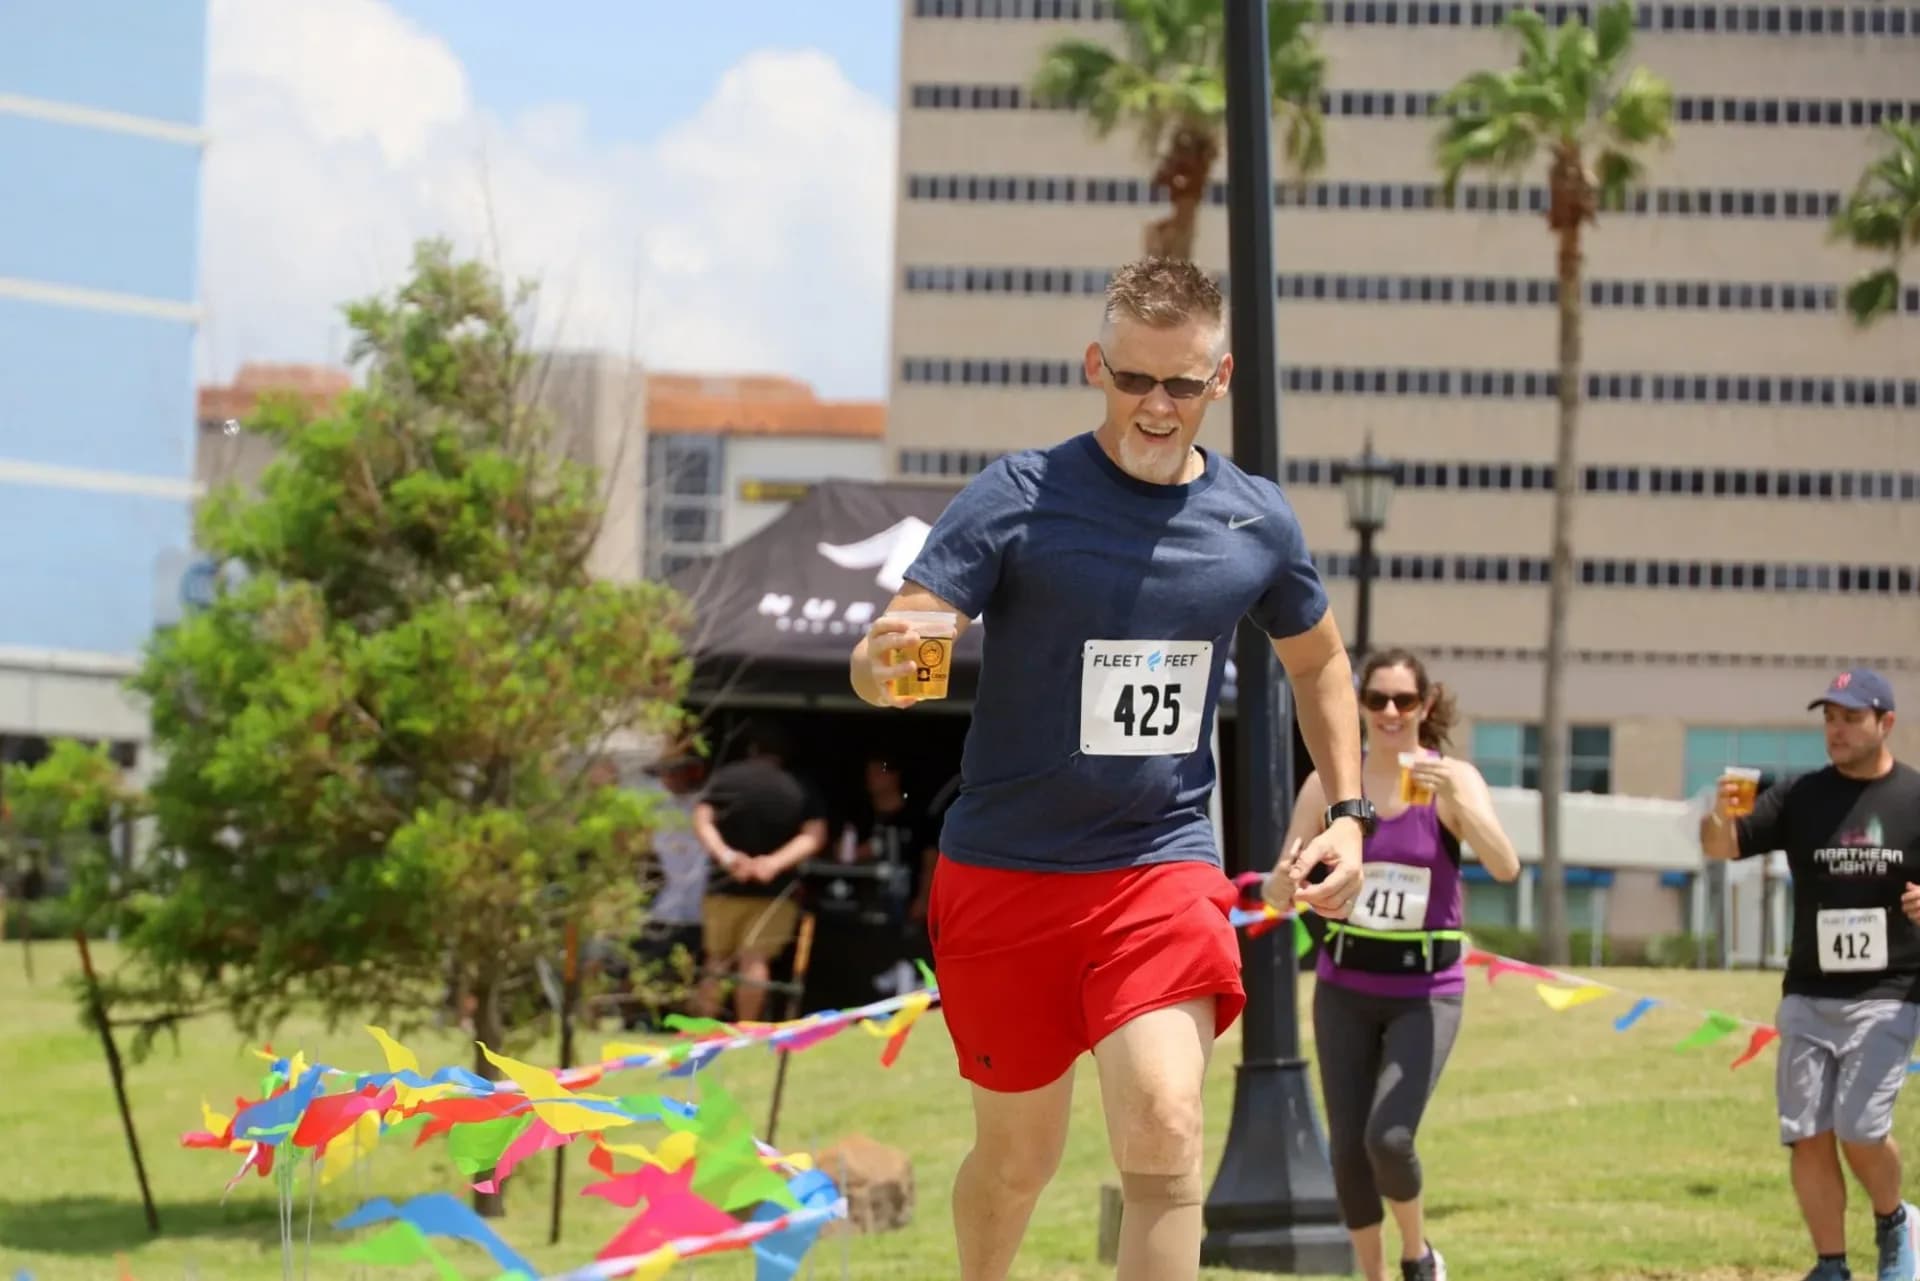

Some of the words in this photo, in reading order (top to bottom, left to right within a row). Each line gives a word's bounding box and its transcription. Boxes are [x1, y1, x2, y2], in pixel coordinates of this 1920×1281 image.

[1092, 654, 1143, 667] FLEET
[1163, 654, 1198, 667] FEET
[1113, 683, 1182, 737] 425
[1365, 888, 1406, 920] 411
[1832, 932, 1871, 960] 412
